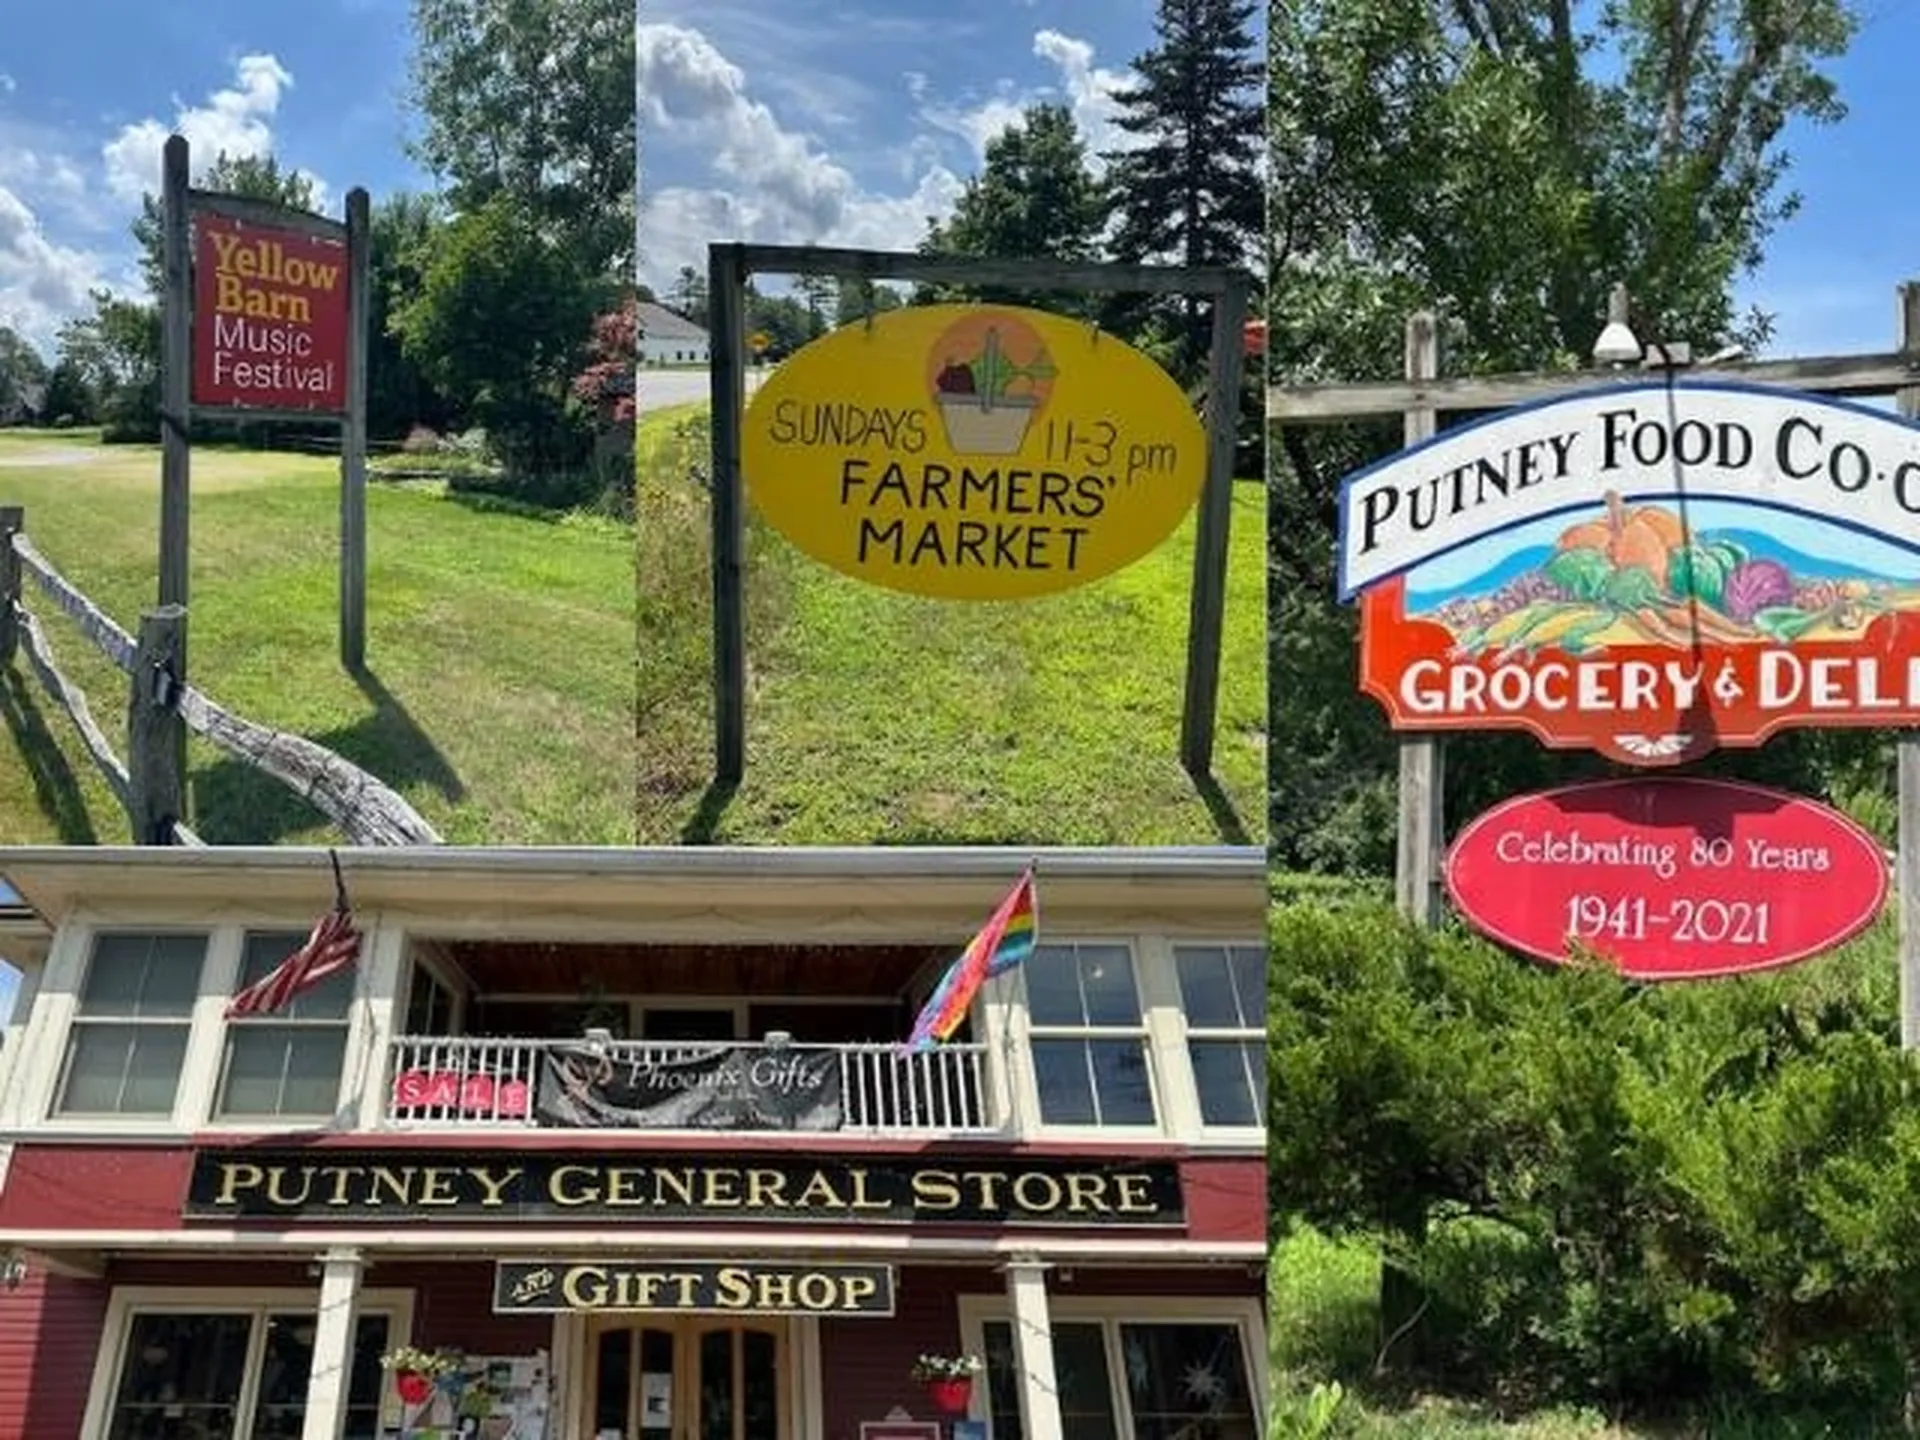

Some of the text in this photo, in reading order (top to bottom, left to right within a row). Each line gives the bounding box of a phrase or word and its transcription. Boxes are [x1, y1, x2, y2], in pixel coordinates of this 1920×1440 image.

[209, 231, 339, 290] Yellow
[215, 272, 312, 323] Barn
[214, 314, 312, 357] Music
[214, 351, 335, 391] Festival
[768, 400, 1177, 485] SUNDAYS 11-3 pm
[840, 459, 1117, 518] FARMERS'
[1358, 430, 1580, 555] PUTNEY
[1599, 409, 1752, 472] FOOD
[858, 519, 1089, 571] MARKET
[1400, 658, 1704, 713] GROCERY
[1713, 657, 1738, 707] &
[1496, 829, 1830, 878] Celebrating 80 Years
[1567, 894, 1768, 944] 1941-2021
[629, 1060, 742, 1090] Phoenix
[751, 1053, 824, 1095] Gifts
[214, 1163, 1159, 1213] PUTNEY GENERAL STORE
[511, 1266, 876, 1310] AND GIFT SHOP
